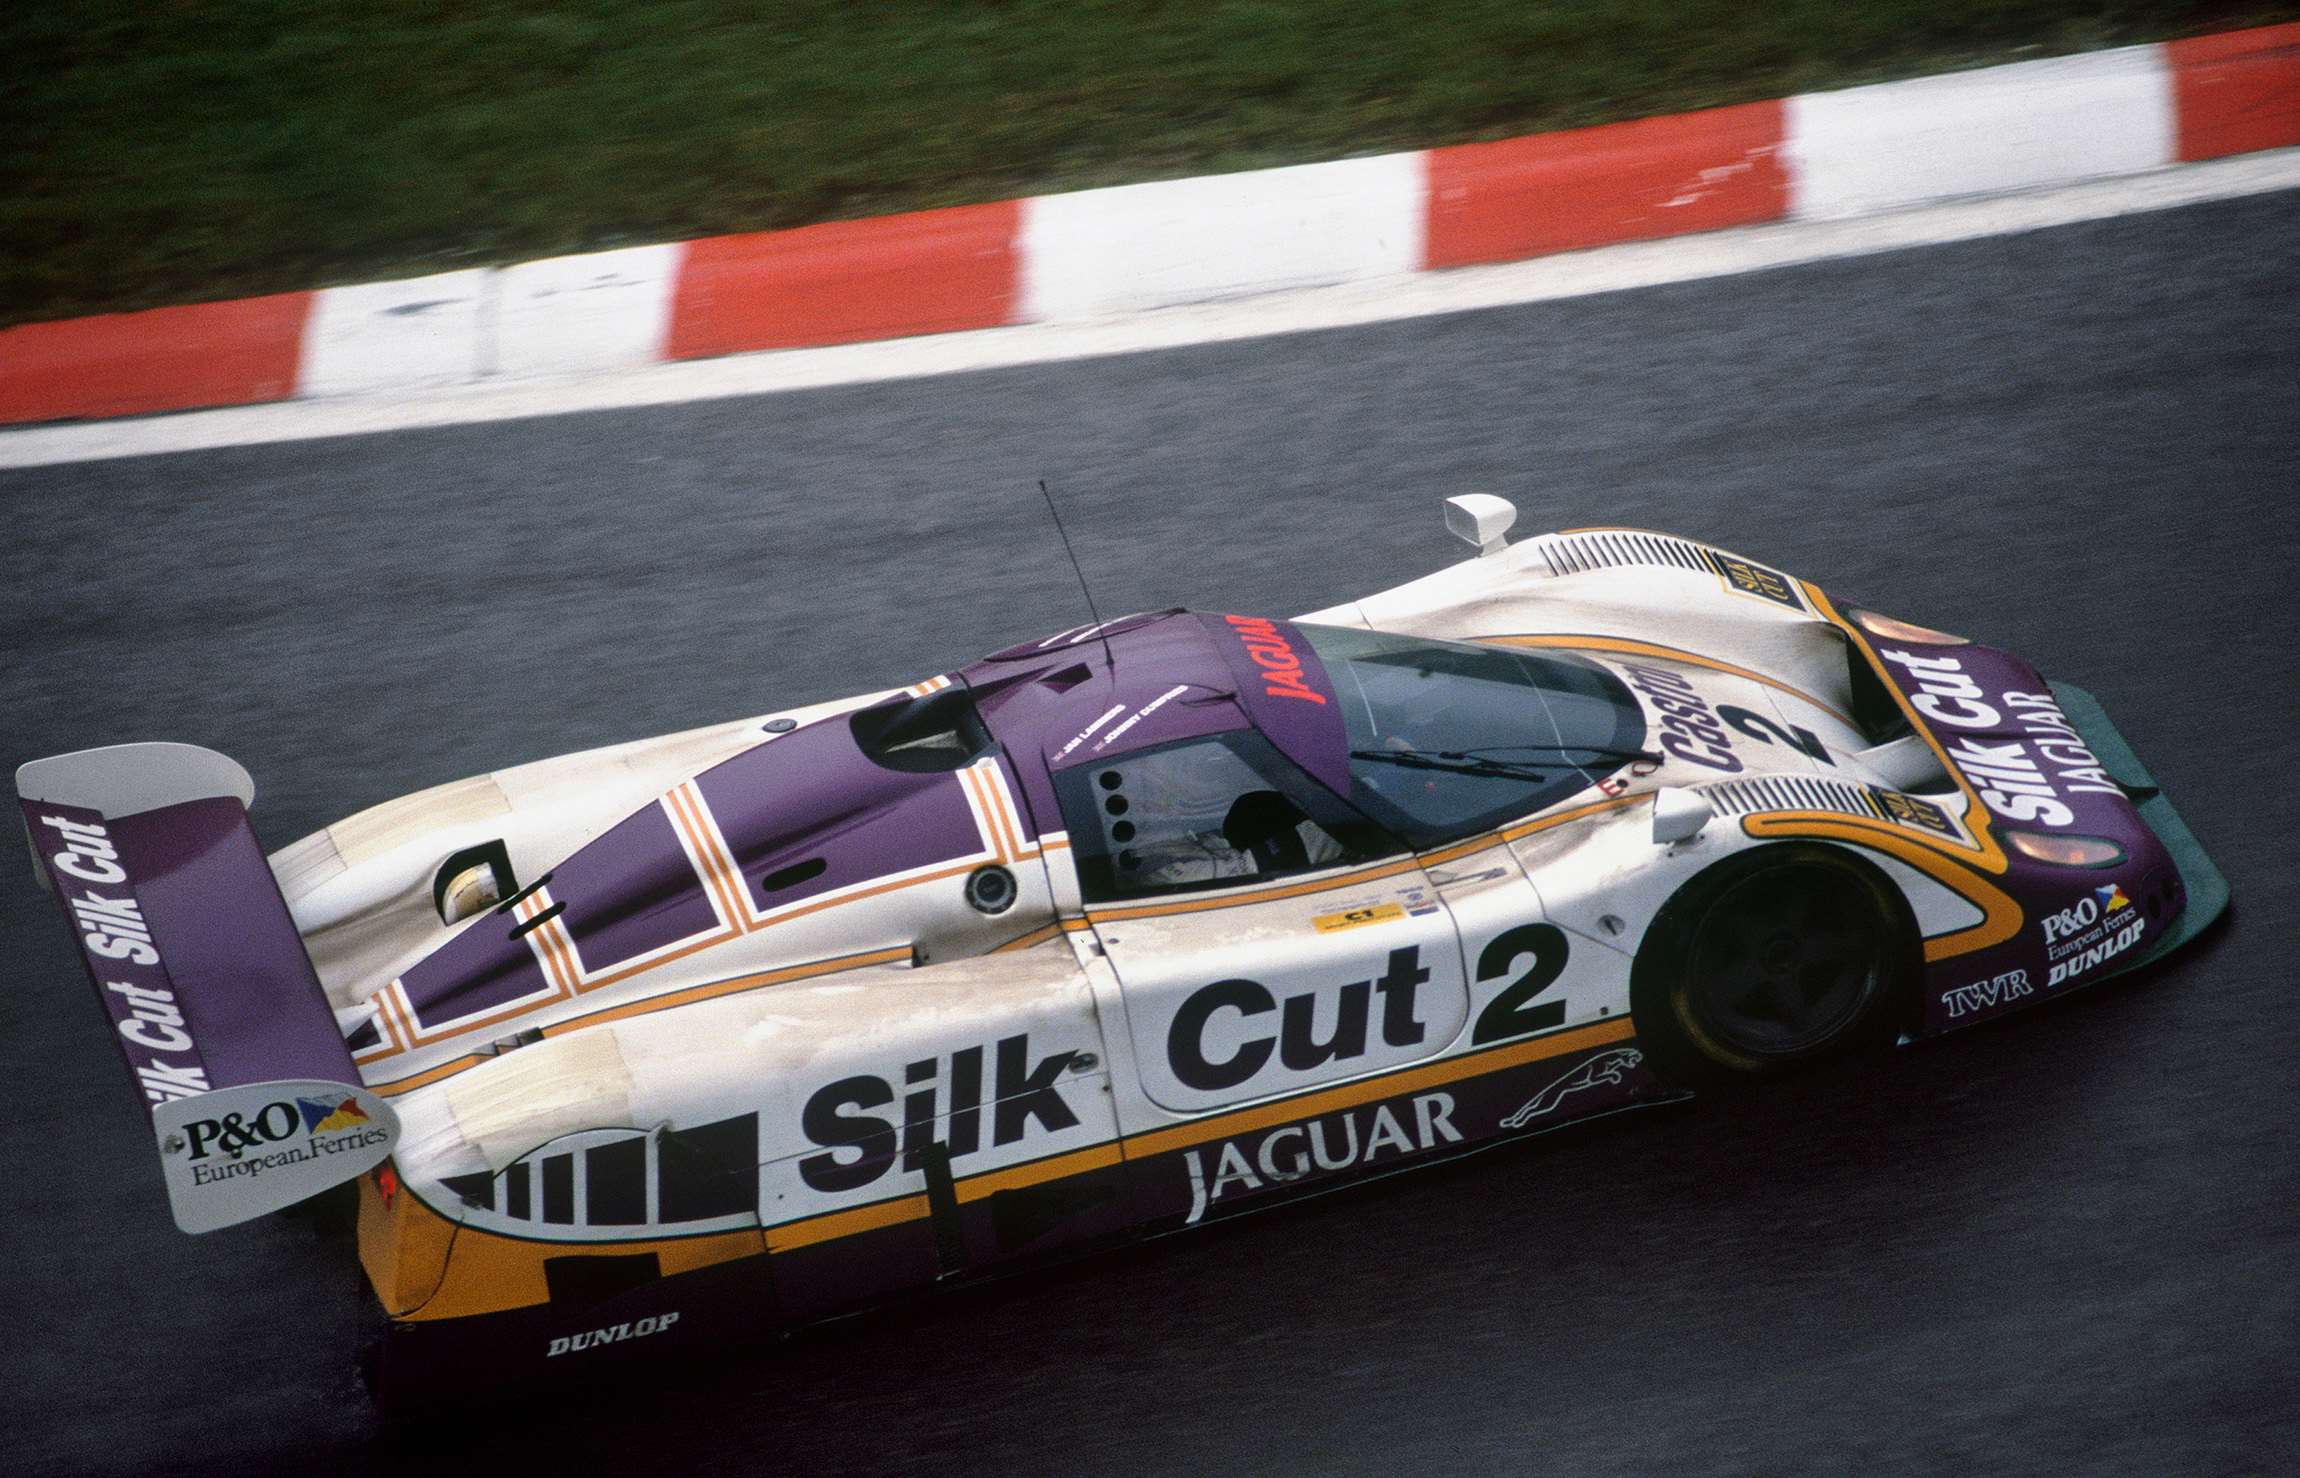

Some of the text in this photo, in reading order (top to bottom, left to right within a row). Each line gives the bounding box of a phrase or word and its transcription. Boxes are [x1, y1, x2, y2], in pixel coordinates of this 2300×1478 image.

[1622, 664, 1744, 773] Castrol
[1716, 704, 1837, 767] 2
[1880, 649, 2074, 826] Silk Cut
[2002, 691, 2128, 800] JAGUAR
[41, 816, 128, 883] Cut
[71, 890, 159, 965] Silk
[2041, 897, 2098, 945] P&O
[2047, 917, 2145, 987] DUNLOP
[2049, 926, 2103, 961] European
[107, 982, 193, 1051] Cut
[1472, 922, 1570, 1047] 2
[1941, 969, 2034, 1018] TWR
[799, 945, 1431, 1193] Silk Cut
[182, 1102, 300, 1161] P&O
[191, 1127, 389, 1186] European Ferries
[1183, 1093, 1465, 1224] JAGUAR
[546, 1311, 681, 1357] DUNLOP
